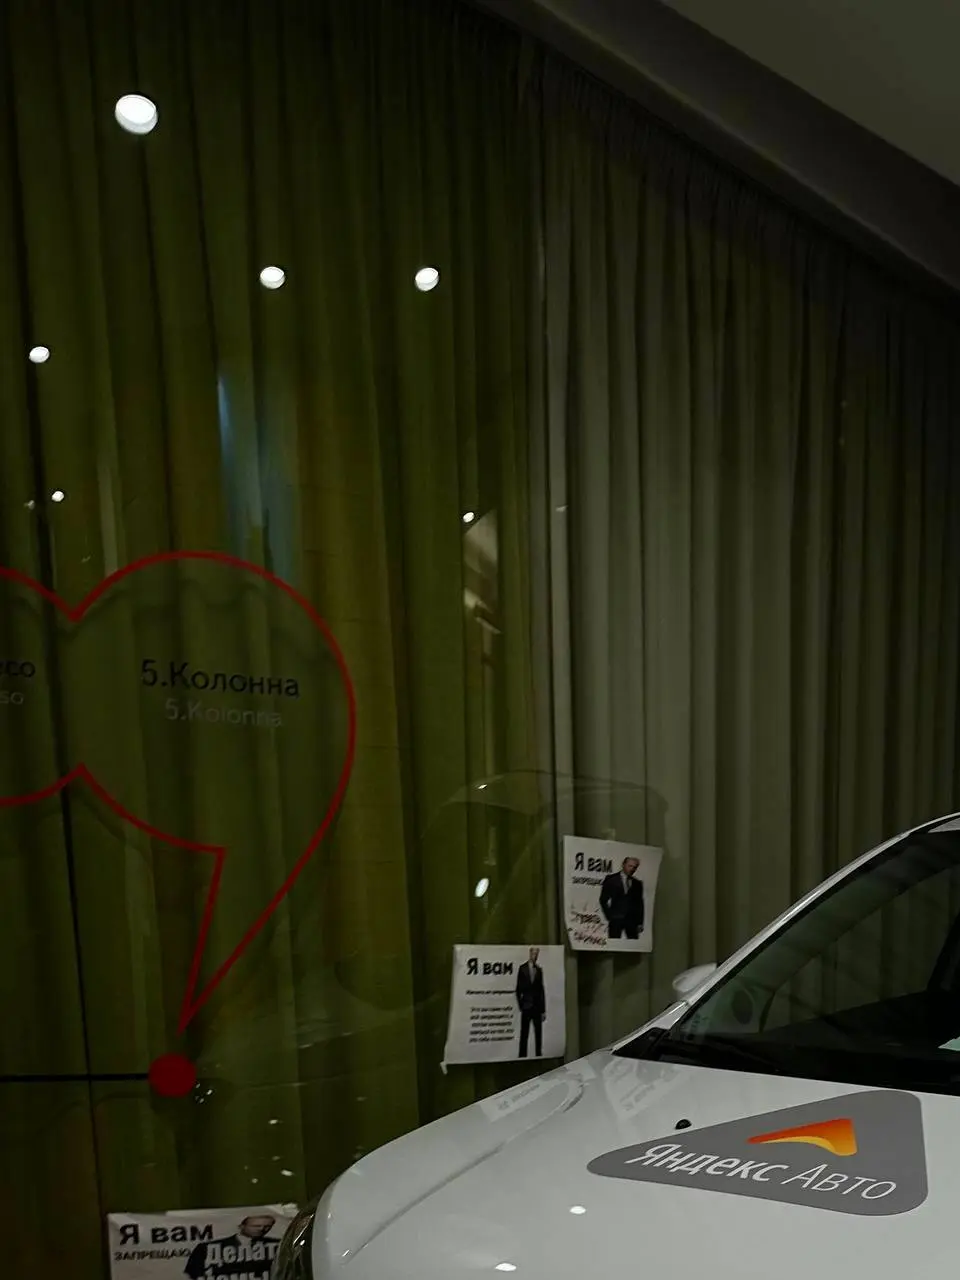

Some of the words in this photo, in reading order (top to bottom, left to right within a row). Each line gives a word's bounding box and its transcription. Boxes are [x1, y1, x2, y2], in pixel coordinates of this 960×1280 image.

[0, 661, 36, 678] со
[141, 658, 300, 697] 5.Колонна
[164, 698, 282, 728] 5.Kolonna
[574, 852, 585, 871] Я
[587, 857, 613, 873] вам
[466, 957, 479, 975] Я
[482, 961, 514, 975] вам
[623, 1143, 789, 1182] Яндекс
[118, 1223, 140, 1246] Я
[151, 1224, 214, 1244] вам
